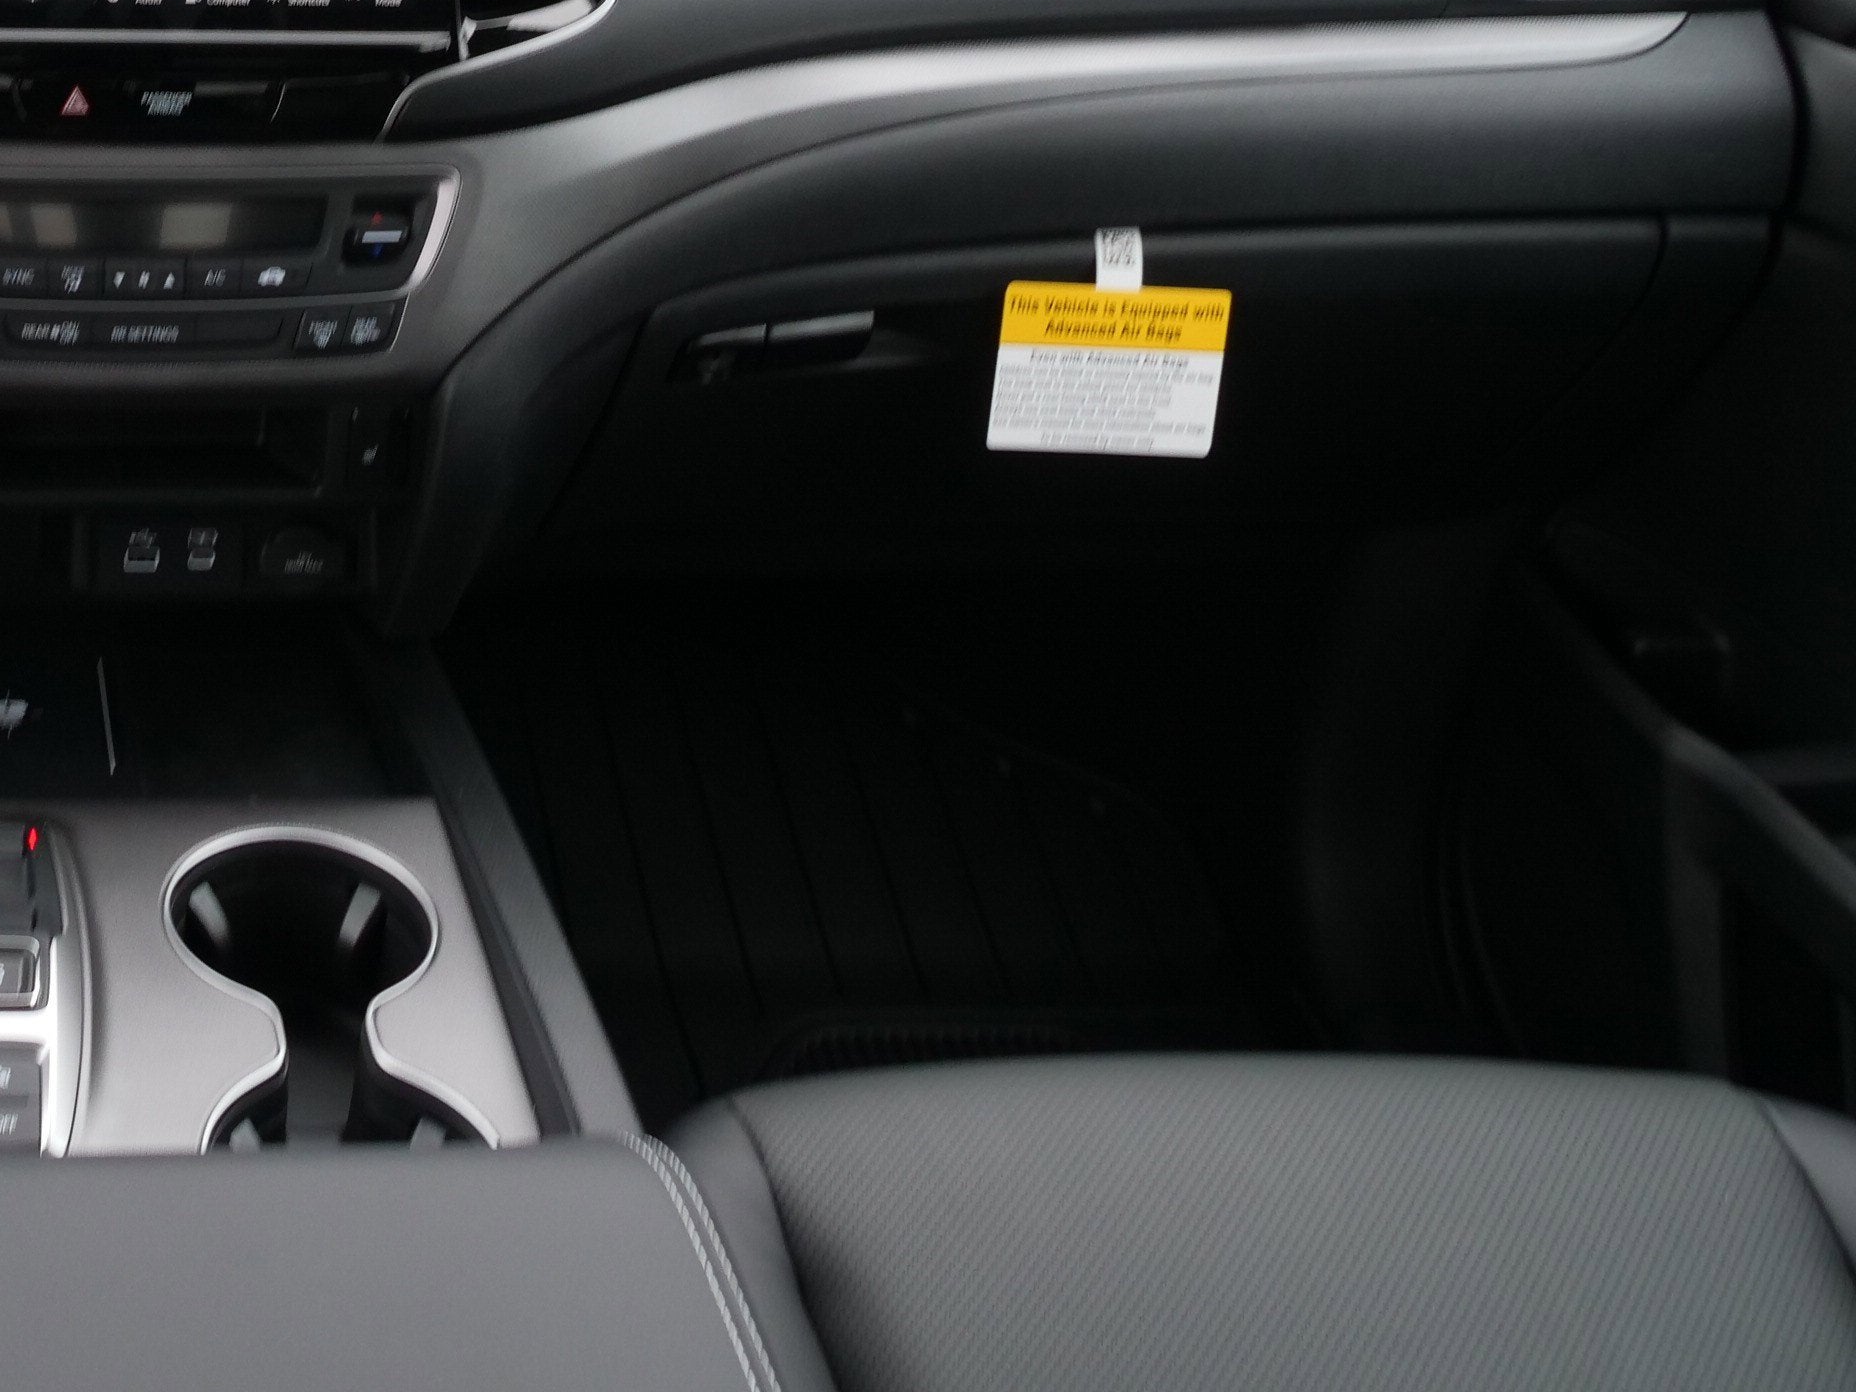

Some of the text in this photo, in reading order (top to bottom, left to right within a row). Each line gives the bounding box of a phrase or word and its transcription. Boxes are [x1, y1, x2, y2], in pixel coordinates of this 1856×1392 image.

[1010, 294, 1040, 315] This
[1045, 295, 1098, 317] Vehicle
[1120, 299, 1189, 322] Equipped
[1193, 302, 1225, 322] with
[1045, 318, 1183, 344] Advanced Air Bags
